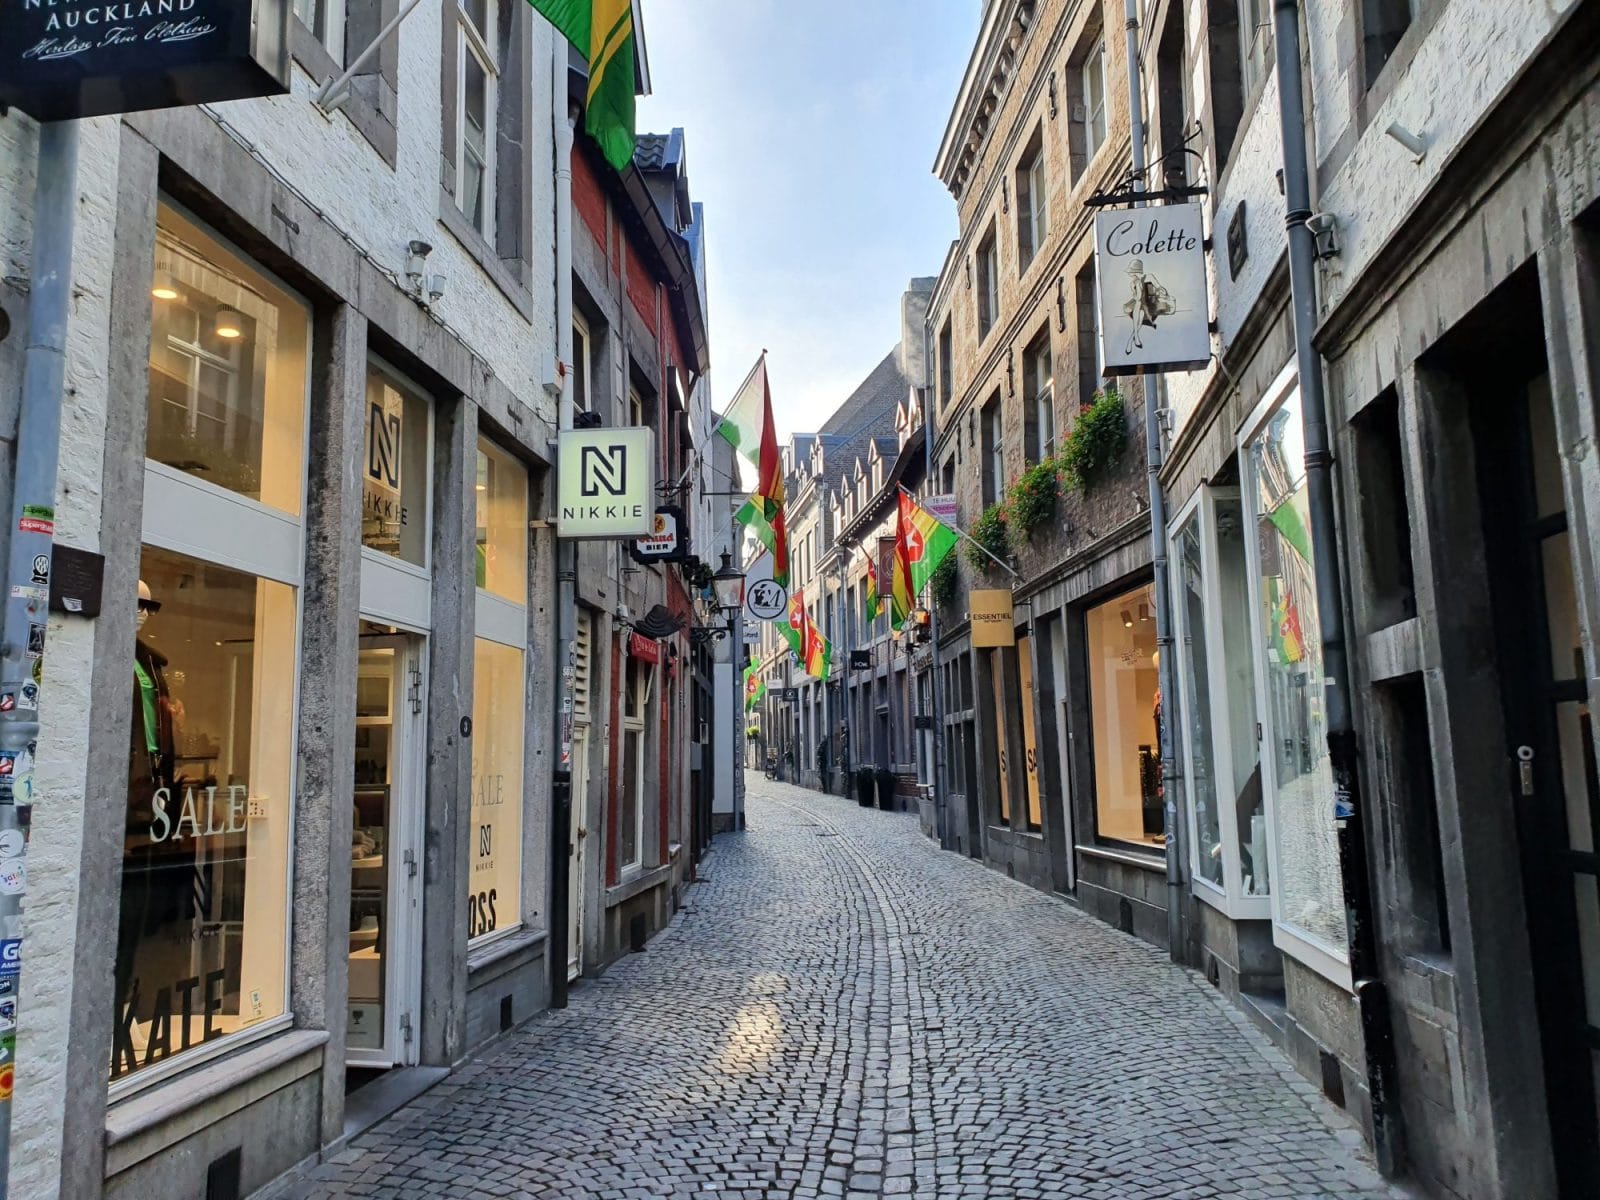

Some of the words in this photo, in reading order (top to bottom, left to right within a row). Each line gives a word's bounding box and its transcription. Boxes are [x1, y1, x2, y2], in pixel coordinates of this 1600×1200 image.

[46, 0, 194, 31] AUCKLAND
[1106, 219, 1197, 257] Colette
[581, 445, 626, 496] N
[563, 505, 642, 519] NIKKIE
[646, 543, 669, 551] BIER
[150, 784, 248, 843] SALE
[475, 860, 494, 872] NIKKIE
